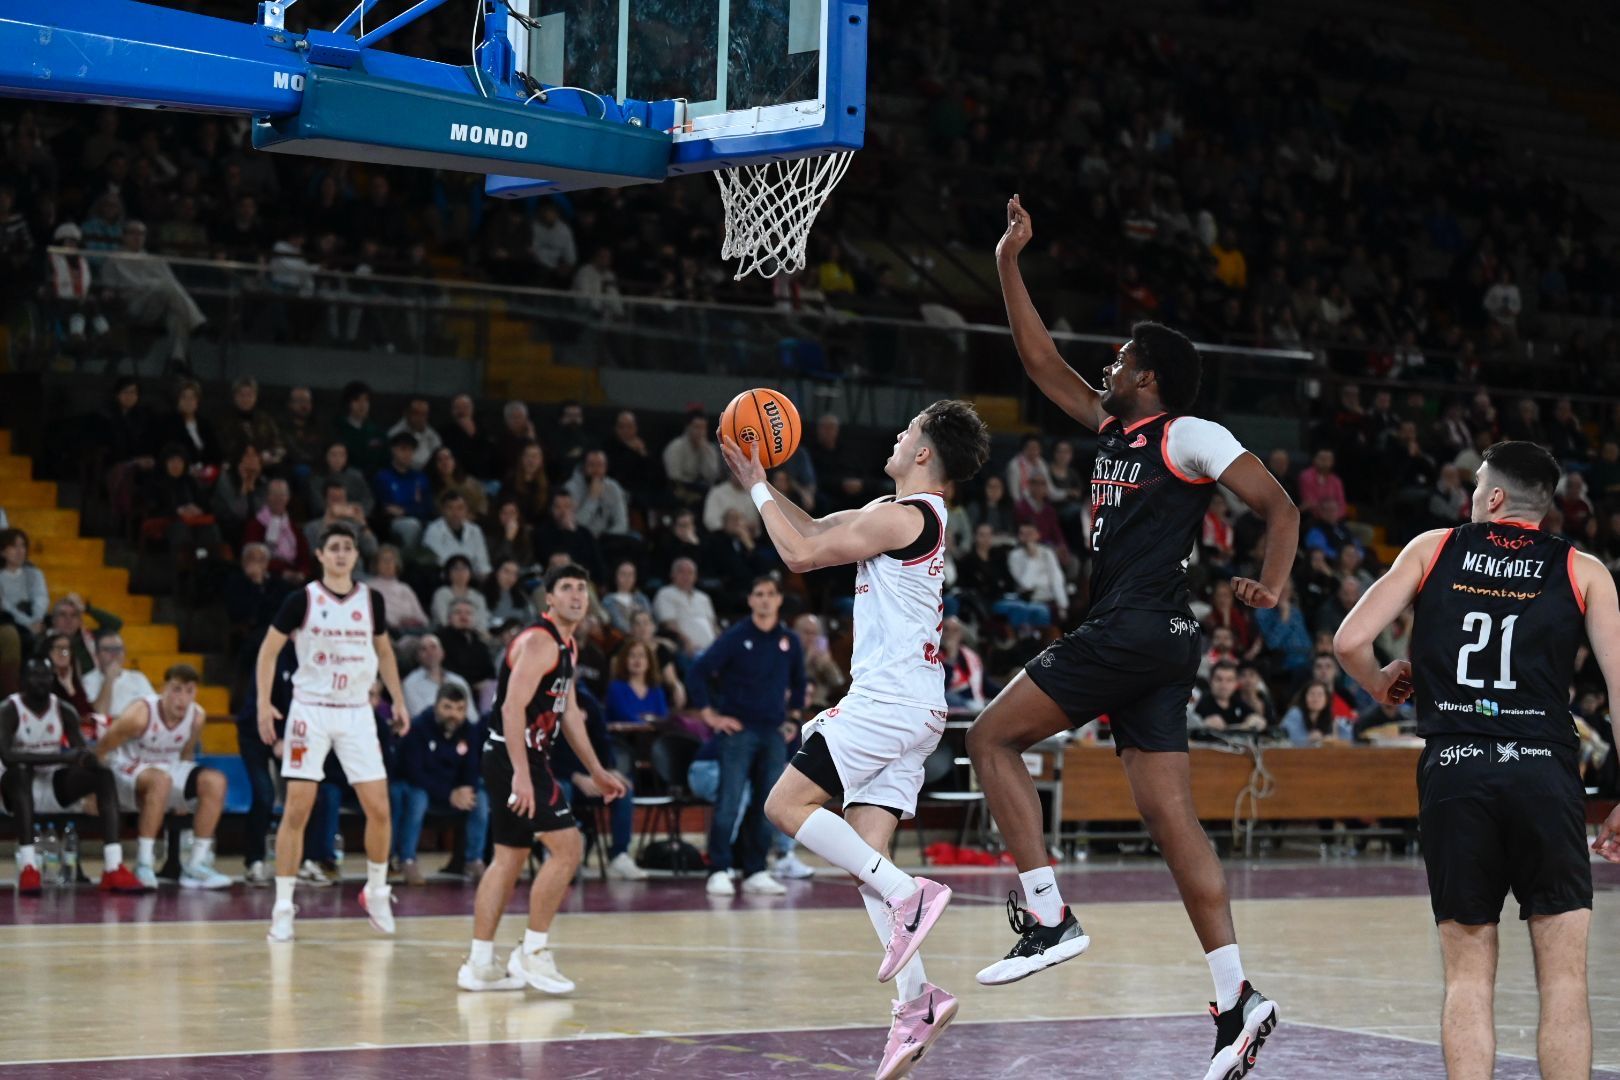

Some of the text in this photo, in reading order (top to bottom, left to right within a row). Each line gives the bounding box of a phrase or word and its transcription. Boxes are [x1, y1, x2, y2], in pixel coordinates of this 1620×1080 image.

[450, 123, 528, 149] MONDO
[763, 400, 784, 454] Wilson
[1092, 517, 1104, 552] 2
[1462, 551, 1545, 579] MENÉNDEZ
[1456, 611, 1519, 690] 21
[332, 672, 348, 690] 10
[292, 719, 307, 738] 10
[1439, 743, 1552, 766] gijón Deporte
